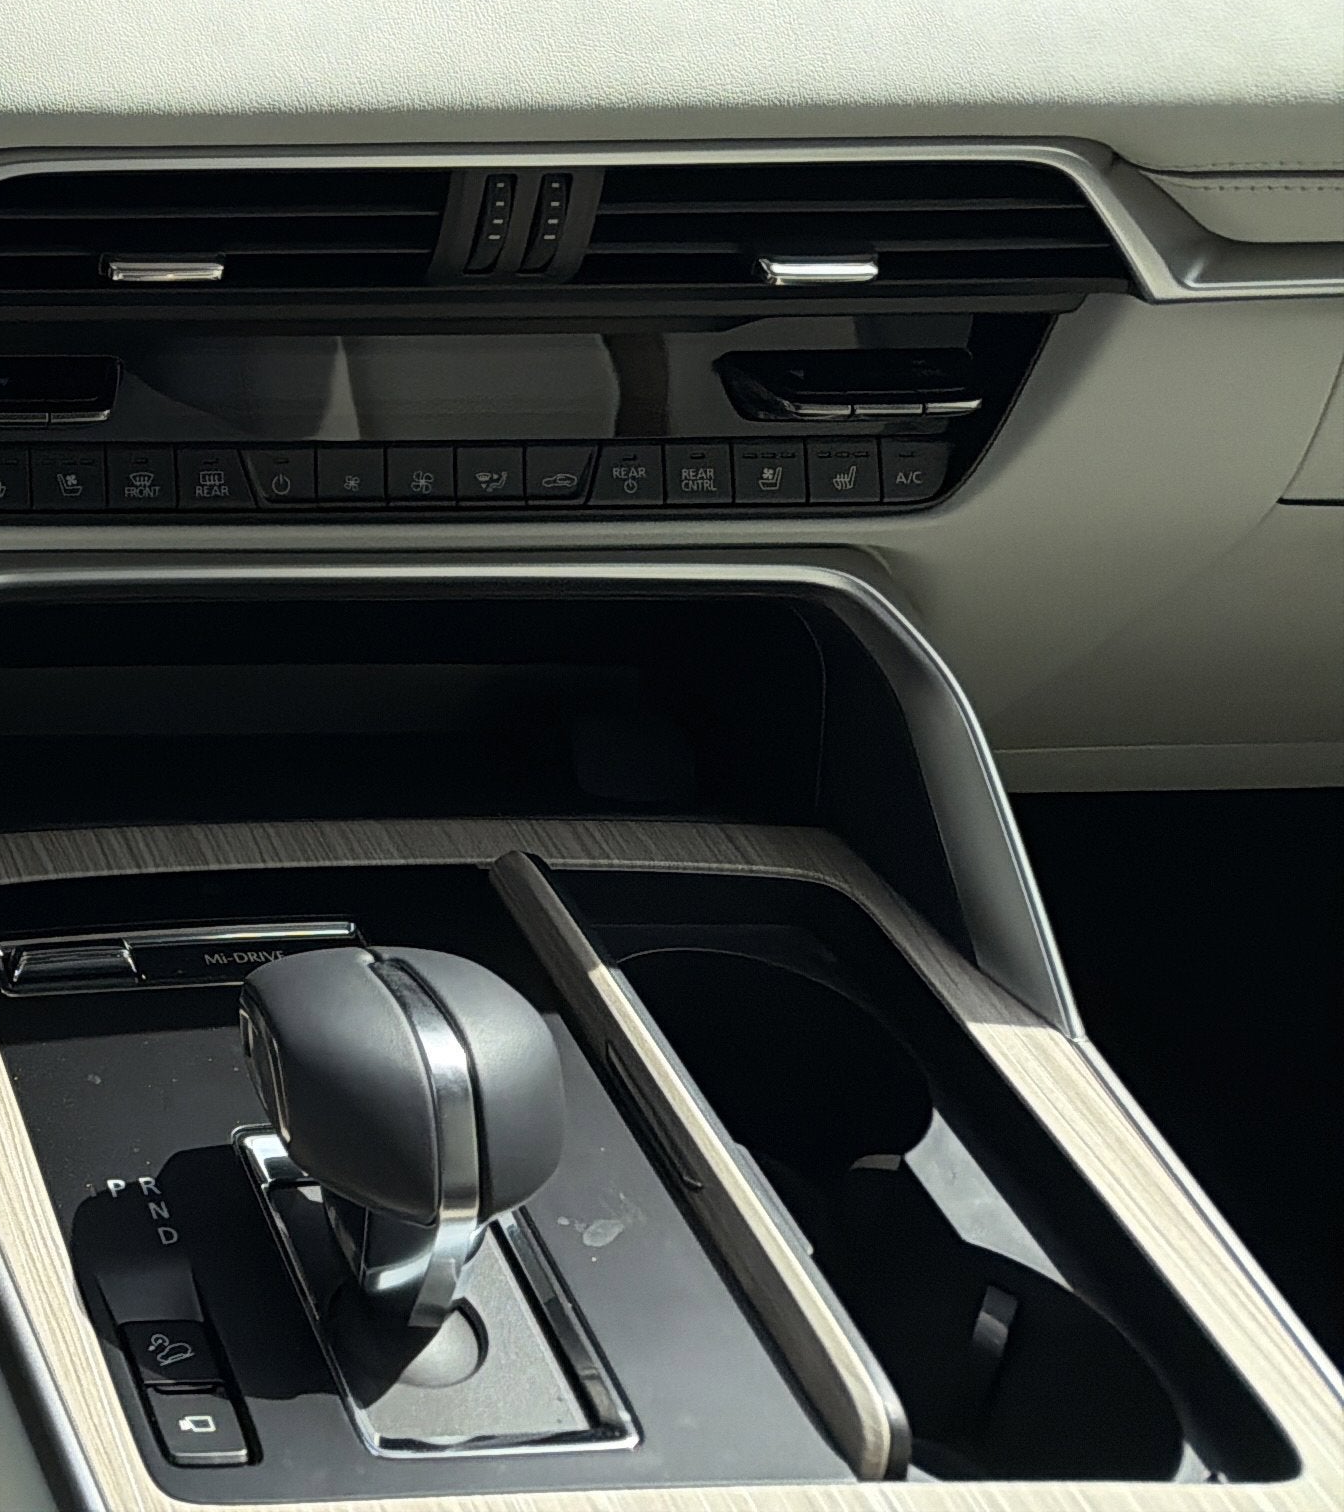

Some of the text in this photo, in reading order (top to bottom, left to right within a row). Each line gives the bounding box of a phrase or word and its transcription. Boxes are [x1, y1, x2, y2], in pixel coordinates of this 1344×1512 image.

[612, 466, 646, 479] REAR
[681, 468, 714, 480] REAR
[895, 471, 923, 485] A/C
[124, 487, 160, 498] FRONT
[195, 486, 230, 497] REAR
[681, 480, 717, 492] CNTRL
[204, 950, 284, 965] Mi-DRIVE
[106, 1178, 126, 1198] P
[138, 1176, 162, 1196] R
[148, 1200, 171, 1220] N
[157, 1226, 179, 1245] D
